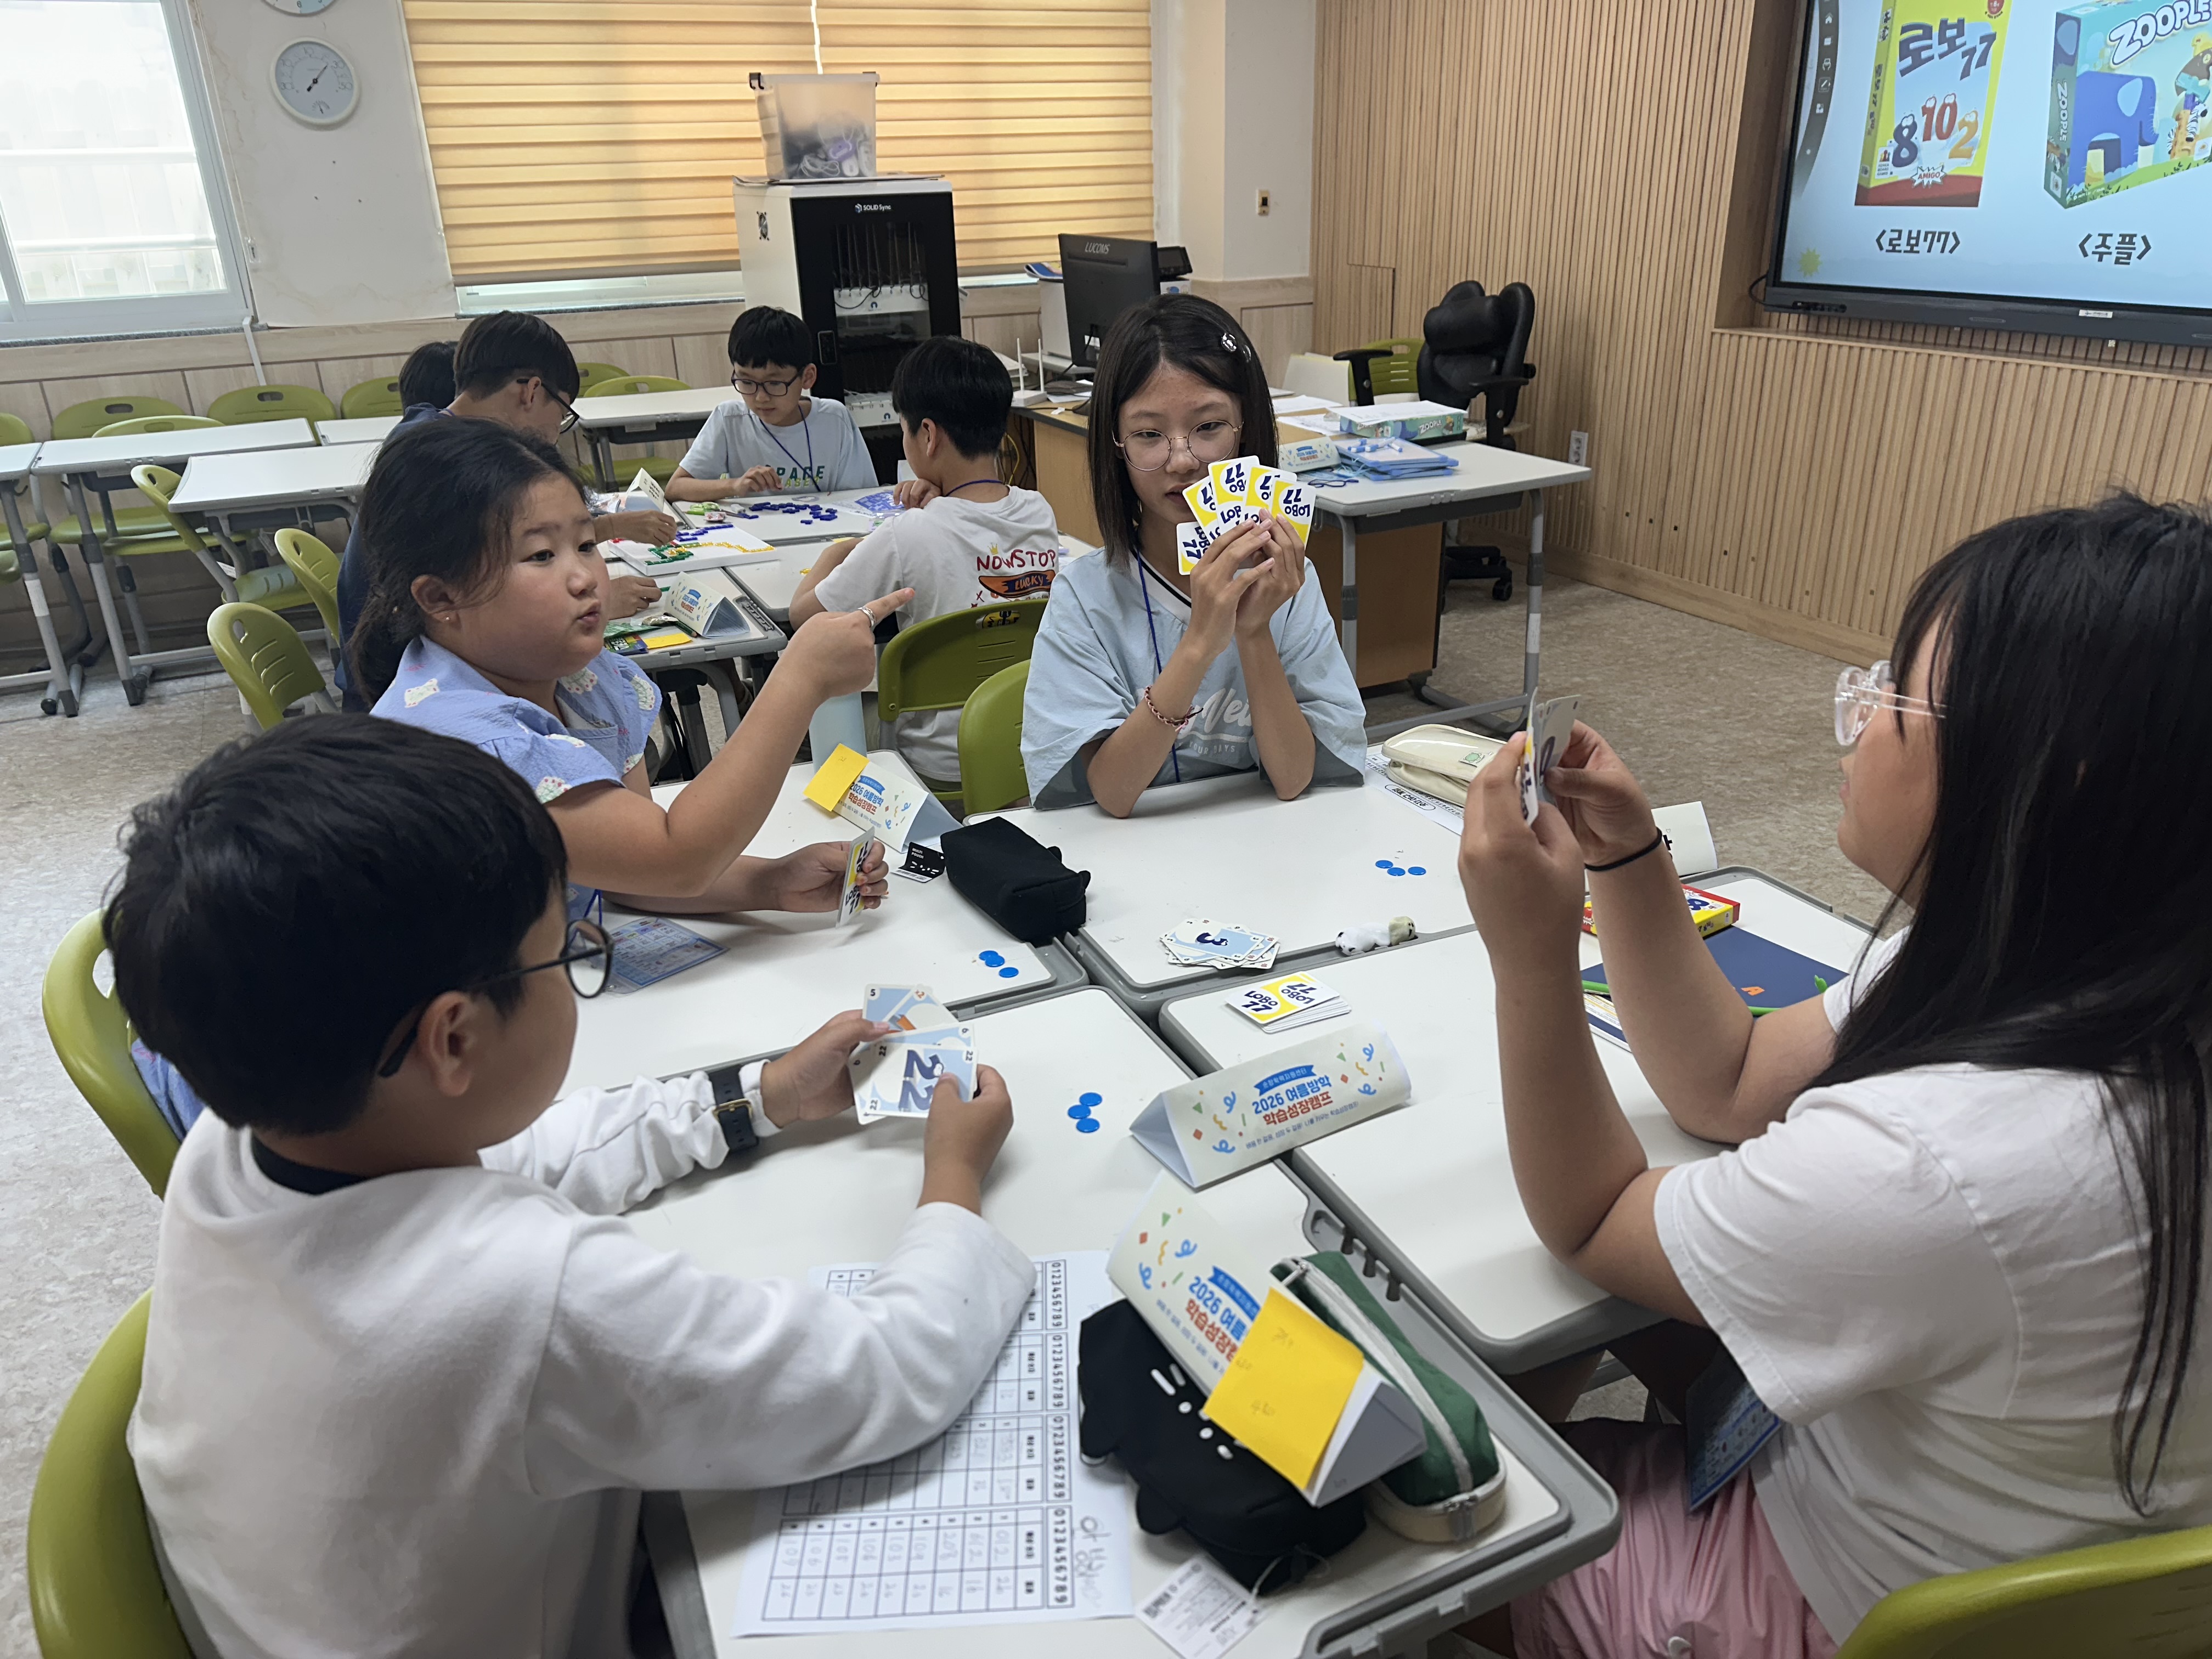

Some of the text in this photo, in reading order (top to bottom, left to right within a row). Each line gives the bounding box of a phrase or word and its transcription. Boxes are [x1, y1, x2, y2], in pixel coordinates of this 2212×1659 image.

[1898, 17, 1997, 81] 로보 77
[2057, 80, 2068, 143] ZOOPLE
[1917, 171, 1940, 179] AMIGO
[1085, 241, 1110, 254] LUCOMS
[1419, 419, 1442, 434] ZOOPLE
[1283, 488, 1302, 505] 77
[1284, 504, 1311, 517] LOBO
[1189, 741, 1236, 755] YOUR DAYS
[911, 851, 924, 860] POUCH
[1196, 932, 1229, 947] 3
[1280, 989, 1316, 1005] LOBO
[1286, 983, 1317, 995] 77
[1242, 1000, 1273, 1013] 77
[1244, 990, 1278, 1007] LOBO
[879, 1045, 887, 1057] 22
[965, 1049, 974, 1062] 22
[898, 1049, 945, 1113] 22
[1251, 1075, 1333, 1115] 2026 여름방학
[870, 1099, 878, 1110] 22
[1262, 1091, 1334, 1127] 학습성장캠프
[1051, 1261, 1062, 1328] 0123456789
[1188, 1275, 1223, 1315] 2026
[1052, 1334, 1063, 1409] 0123456789
[1052, 1414, 1065, 1499] 0123456789
[1054, 1509, 1067, 1606] 0123456789
